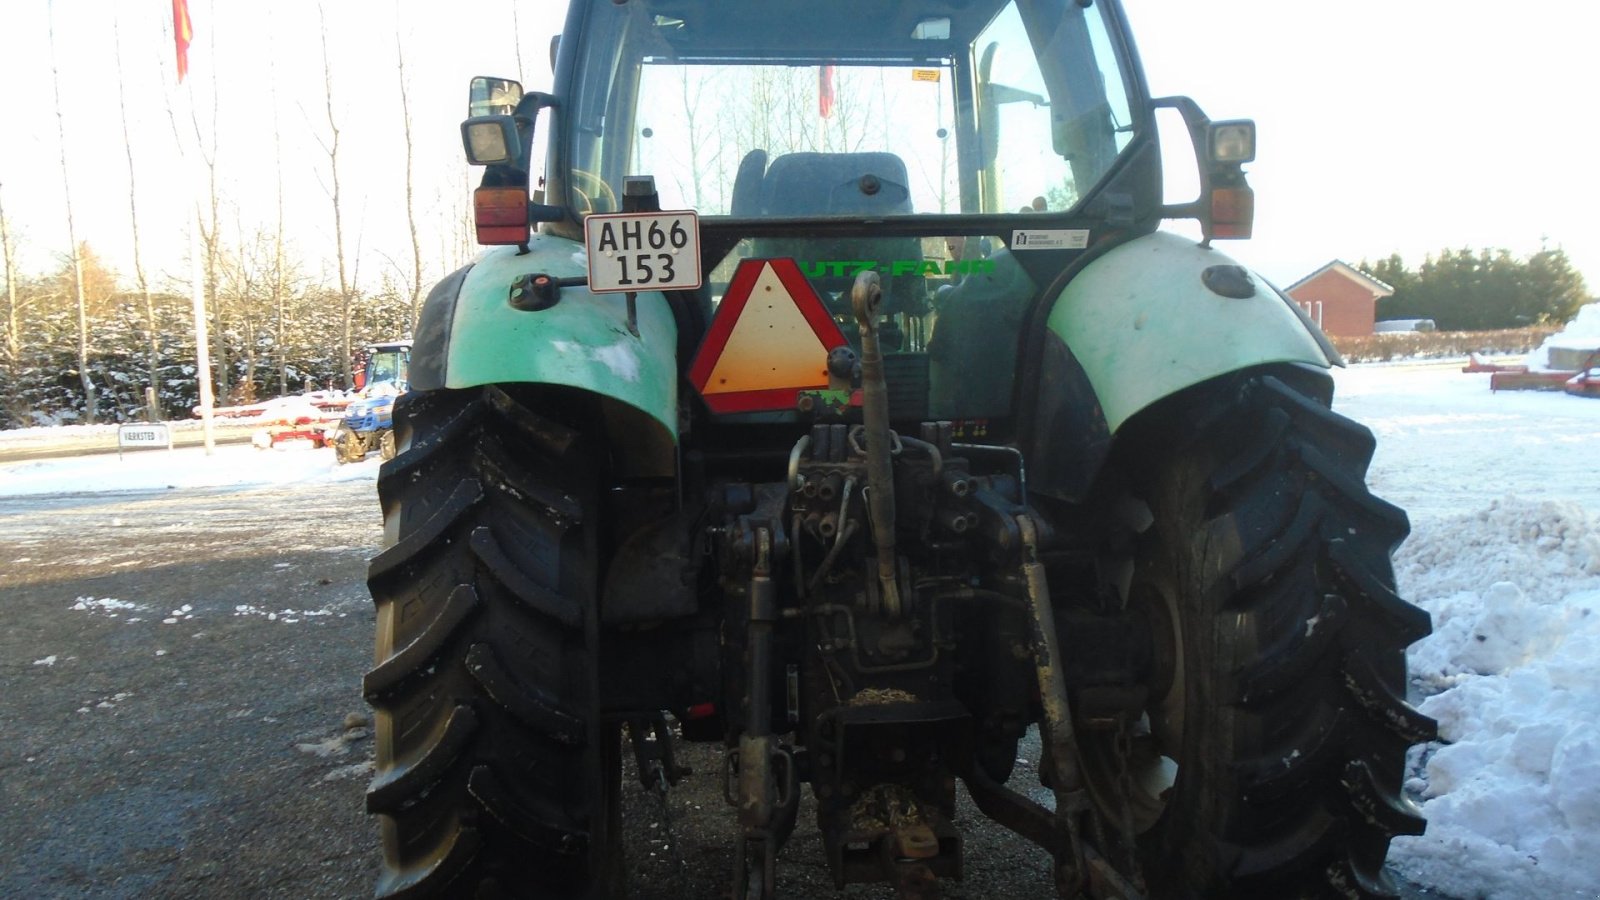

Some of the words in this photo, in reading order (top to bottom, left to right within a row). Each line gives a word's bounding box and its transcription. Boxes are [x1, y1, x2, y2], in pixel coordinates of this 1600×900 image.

[598, 219, 688, 252] AH66
[616, 253, 676, 285] 153
[799, 260, 996, 278] UTZ-FAHR
